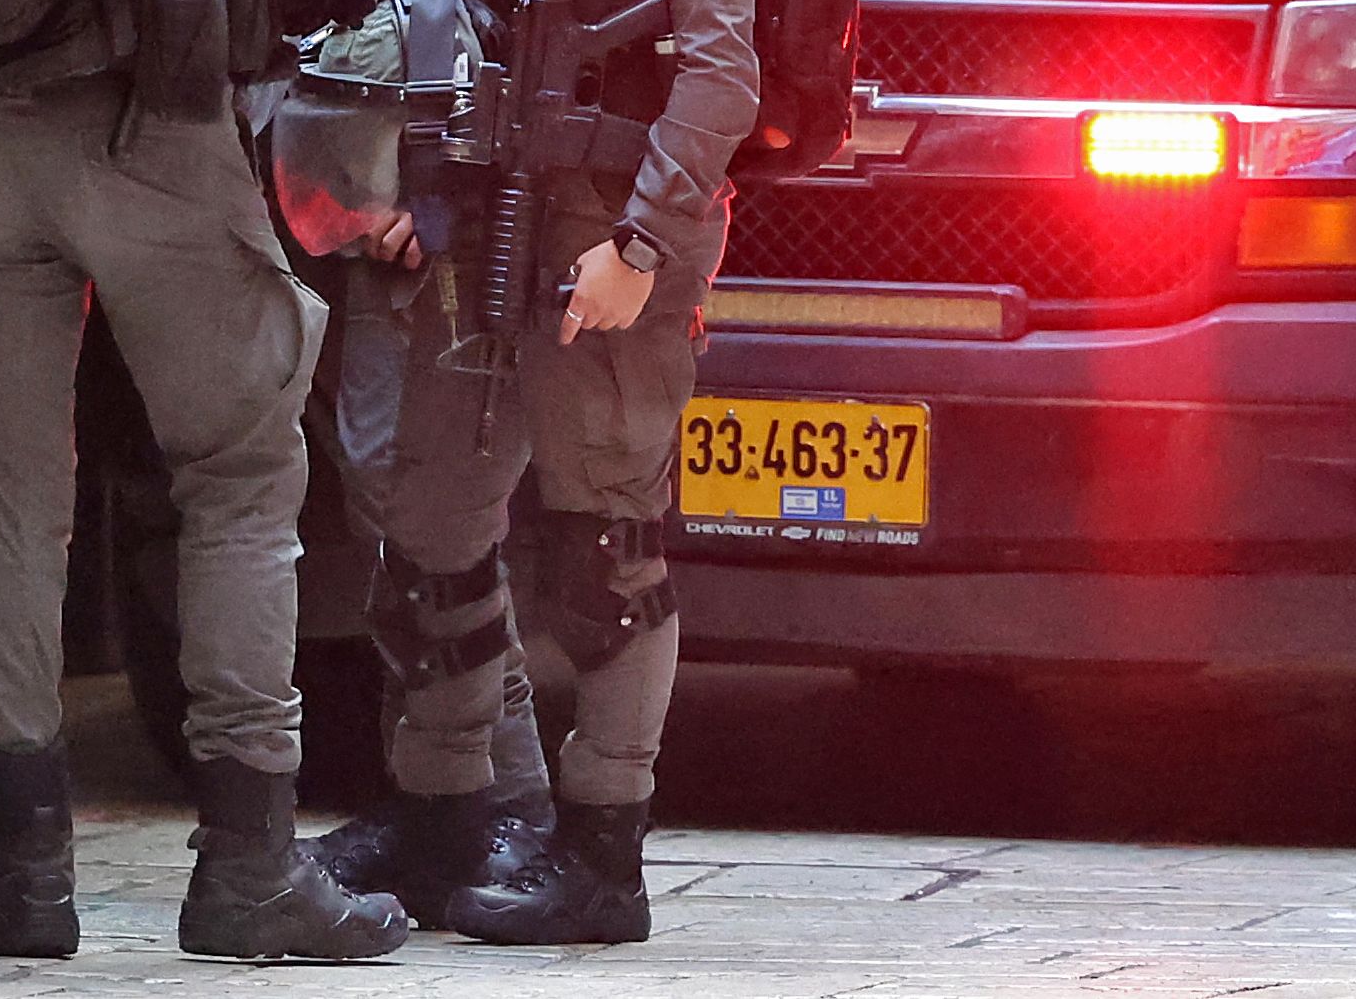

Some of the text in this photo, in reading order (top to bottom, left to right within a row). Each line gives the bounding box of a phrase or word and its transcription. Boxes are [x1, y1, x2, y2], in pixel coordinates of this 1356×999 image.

[824, 489, 839, 502] IL
[685, 522, 919, 545] CHEVROLET FIND NEW ROADS
